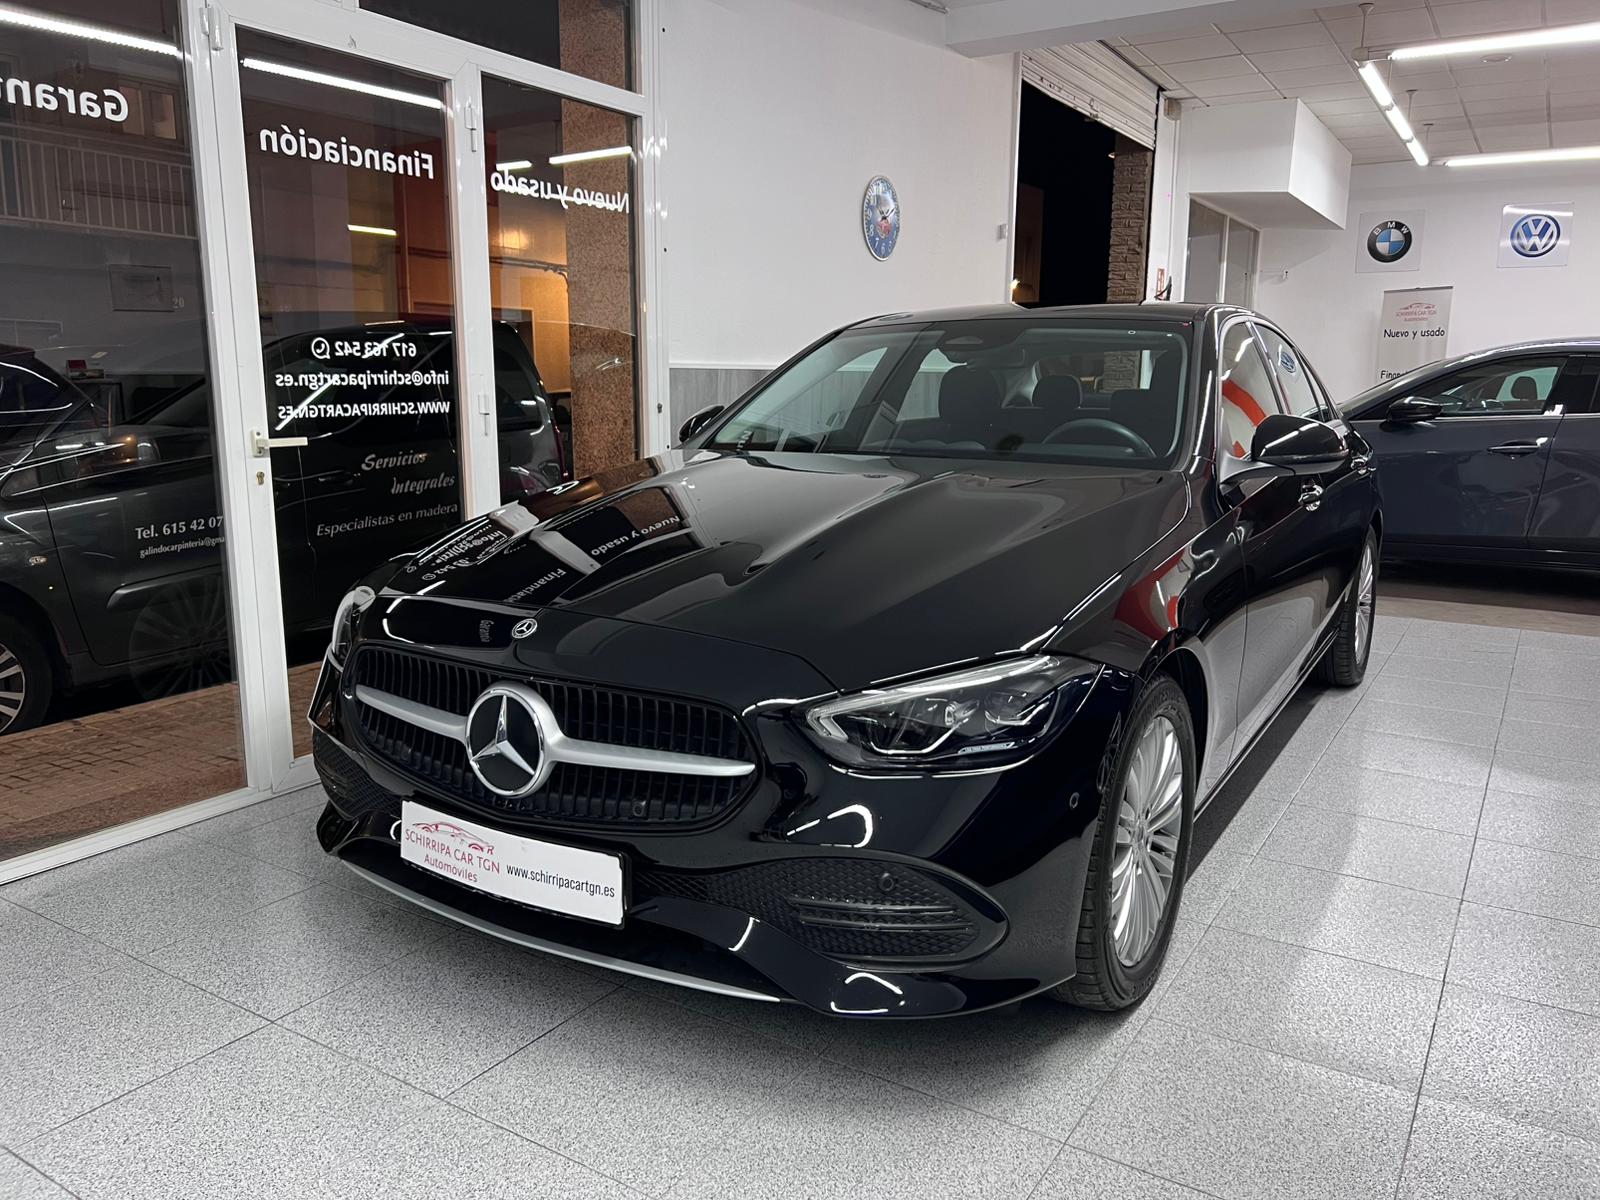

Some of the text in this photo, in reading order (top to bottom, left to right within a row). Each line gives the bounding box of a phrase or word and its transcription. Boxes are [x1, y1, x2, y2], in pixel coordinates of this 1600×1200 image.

[1373, 220, 1409, 236] BMW
[1384, 326, 1445, 340] Nuevo y usado
[361, 450, 428, 471] Servicios
[391, 472, 456, 495] Integrales
[135, 515, 223, 540] Tel. 615 42 07
[316, 503, 458, 538] Especialistas en madera
[405, 828, 500, 875] SCHIRRIPA CAR TGN
[424, 853, 478, 883] Automoviles
[506, 864, 615, 898] www.schirripacartgn.es
